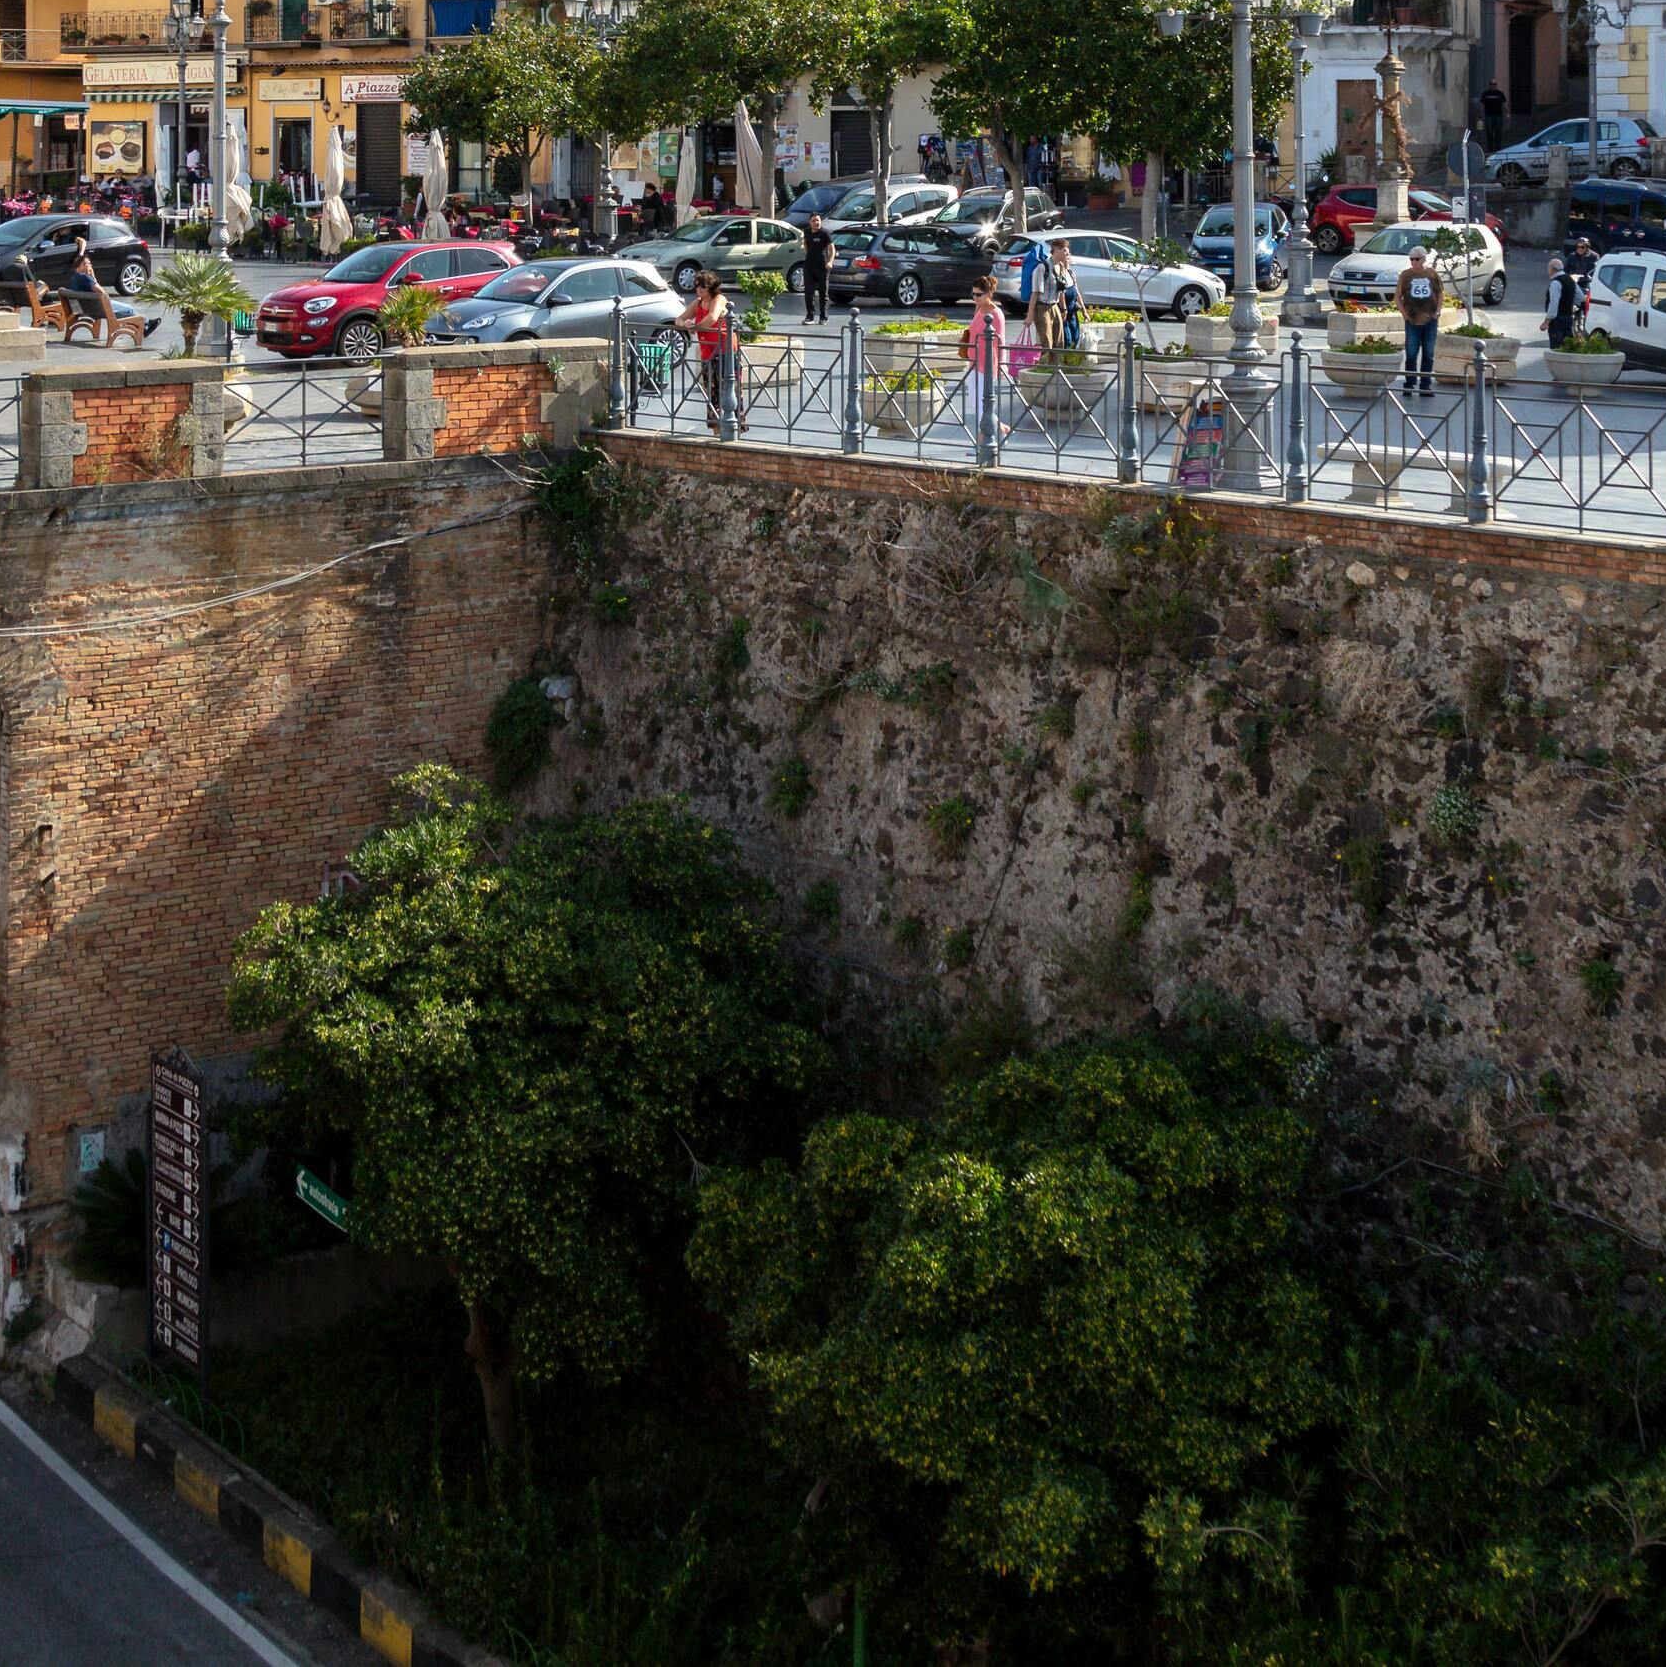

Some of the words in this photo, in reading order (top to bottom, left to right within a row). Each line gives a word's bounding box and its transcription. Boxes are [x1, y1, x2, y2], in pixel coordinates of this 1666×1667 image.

[85, 66, 148, 82] GELATERIA
[166, 65, 235, 80] ARIGIANE
[344, 82, 354, 94] A
[1413, 285, 1428, 295] 66
[178, 1074, 194, 1090] PIZZO
[155, 1180, 177, 1204] STAZIONE
[309, 1183, 339, 1218] autostrada
